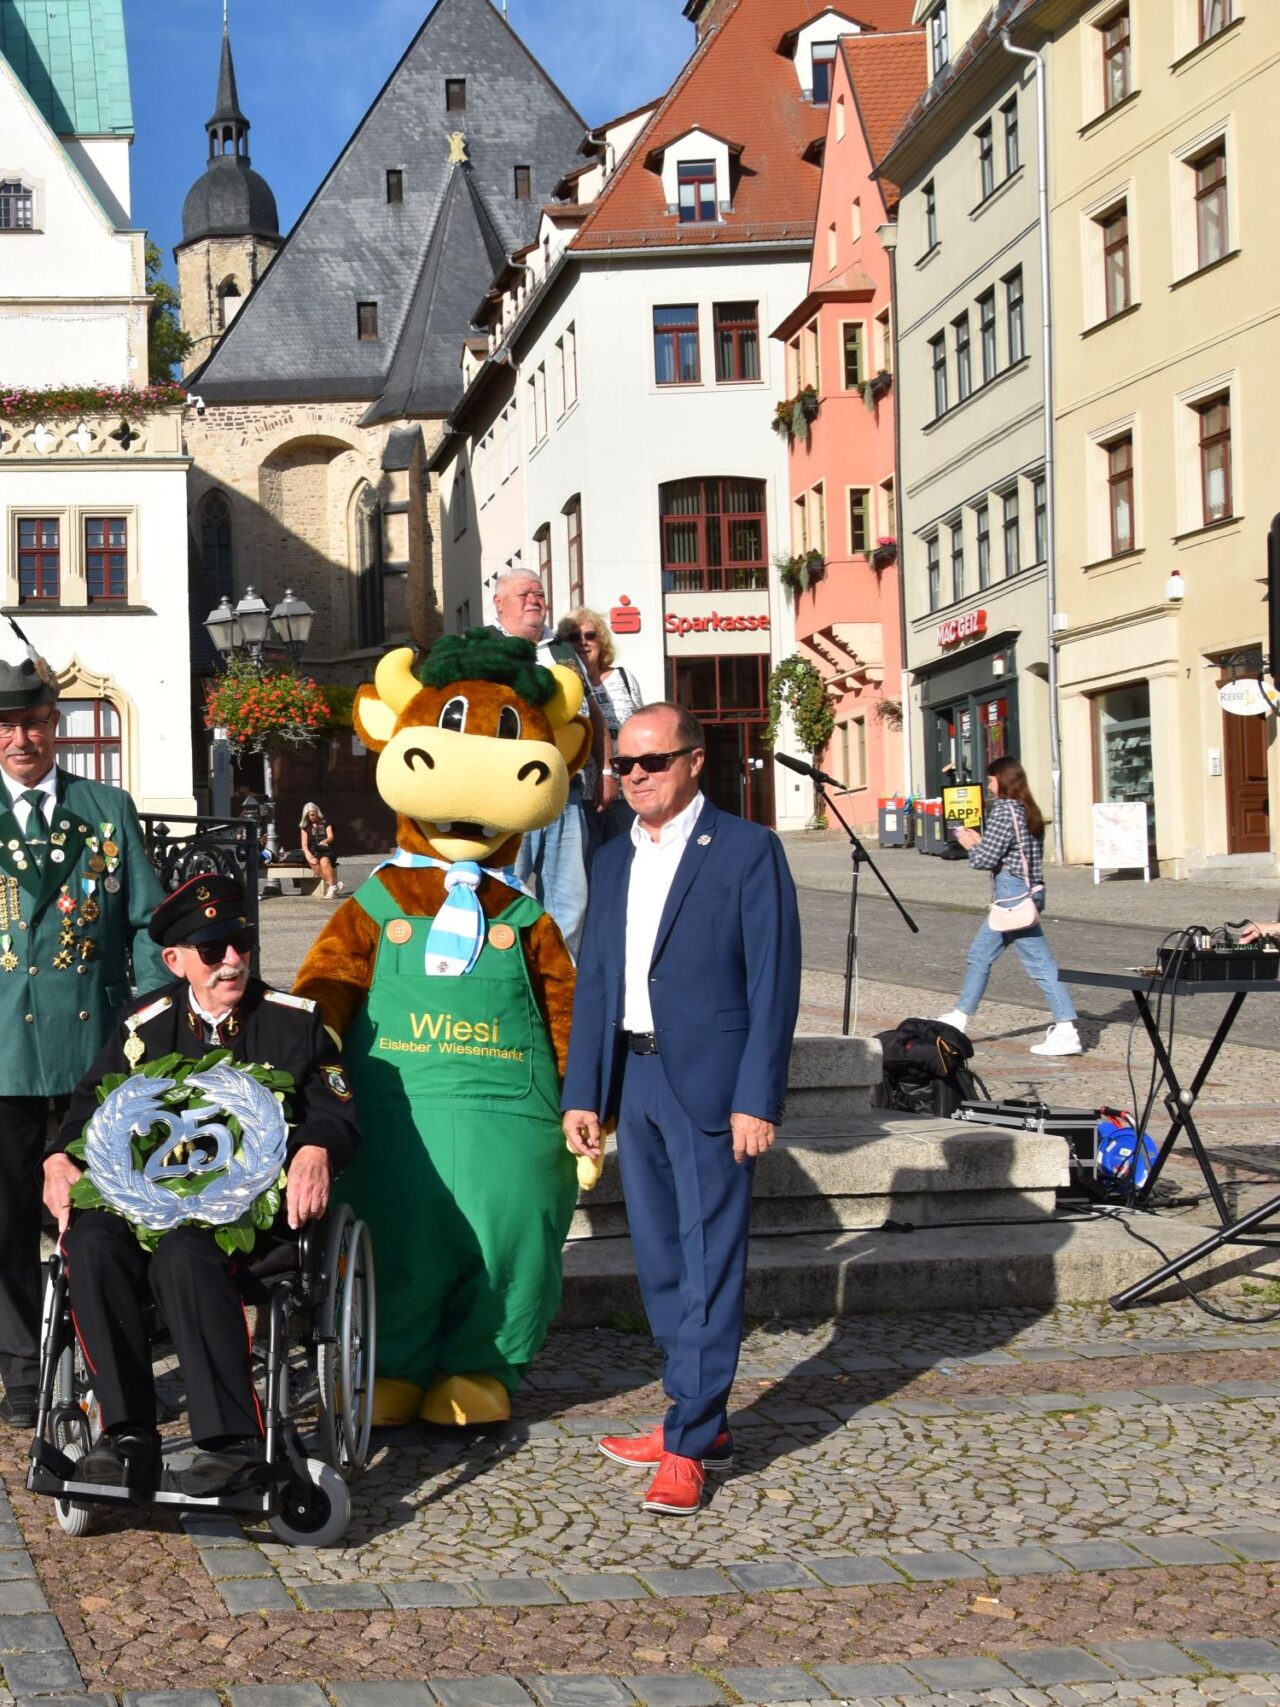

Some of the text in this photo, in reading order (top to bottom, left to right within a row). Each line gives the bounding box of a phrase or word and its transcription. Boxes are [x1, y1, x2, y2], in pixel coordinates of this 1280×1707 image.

[665, 611, 771, 638] Sparkasse
[957, 611, 978, 638] GEIZ
[947, 808, 979, 819] APP?
[410, 1012, 500, 1044] Wiesi
[379, 1037, 524, 1062] Eisleber Wiesenmarkt
[132, 1104, 234, 1181] 25
